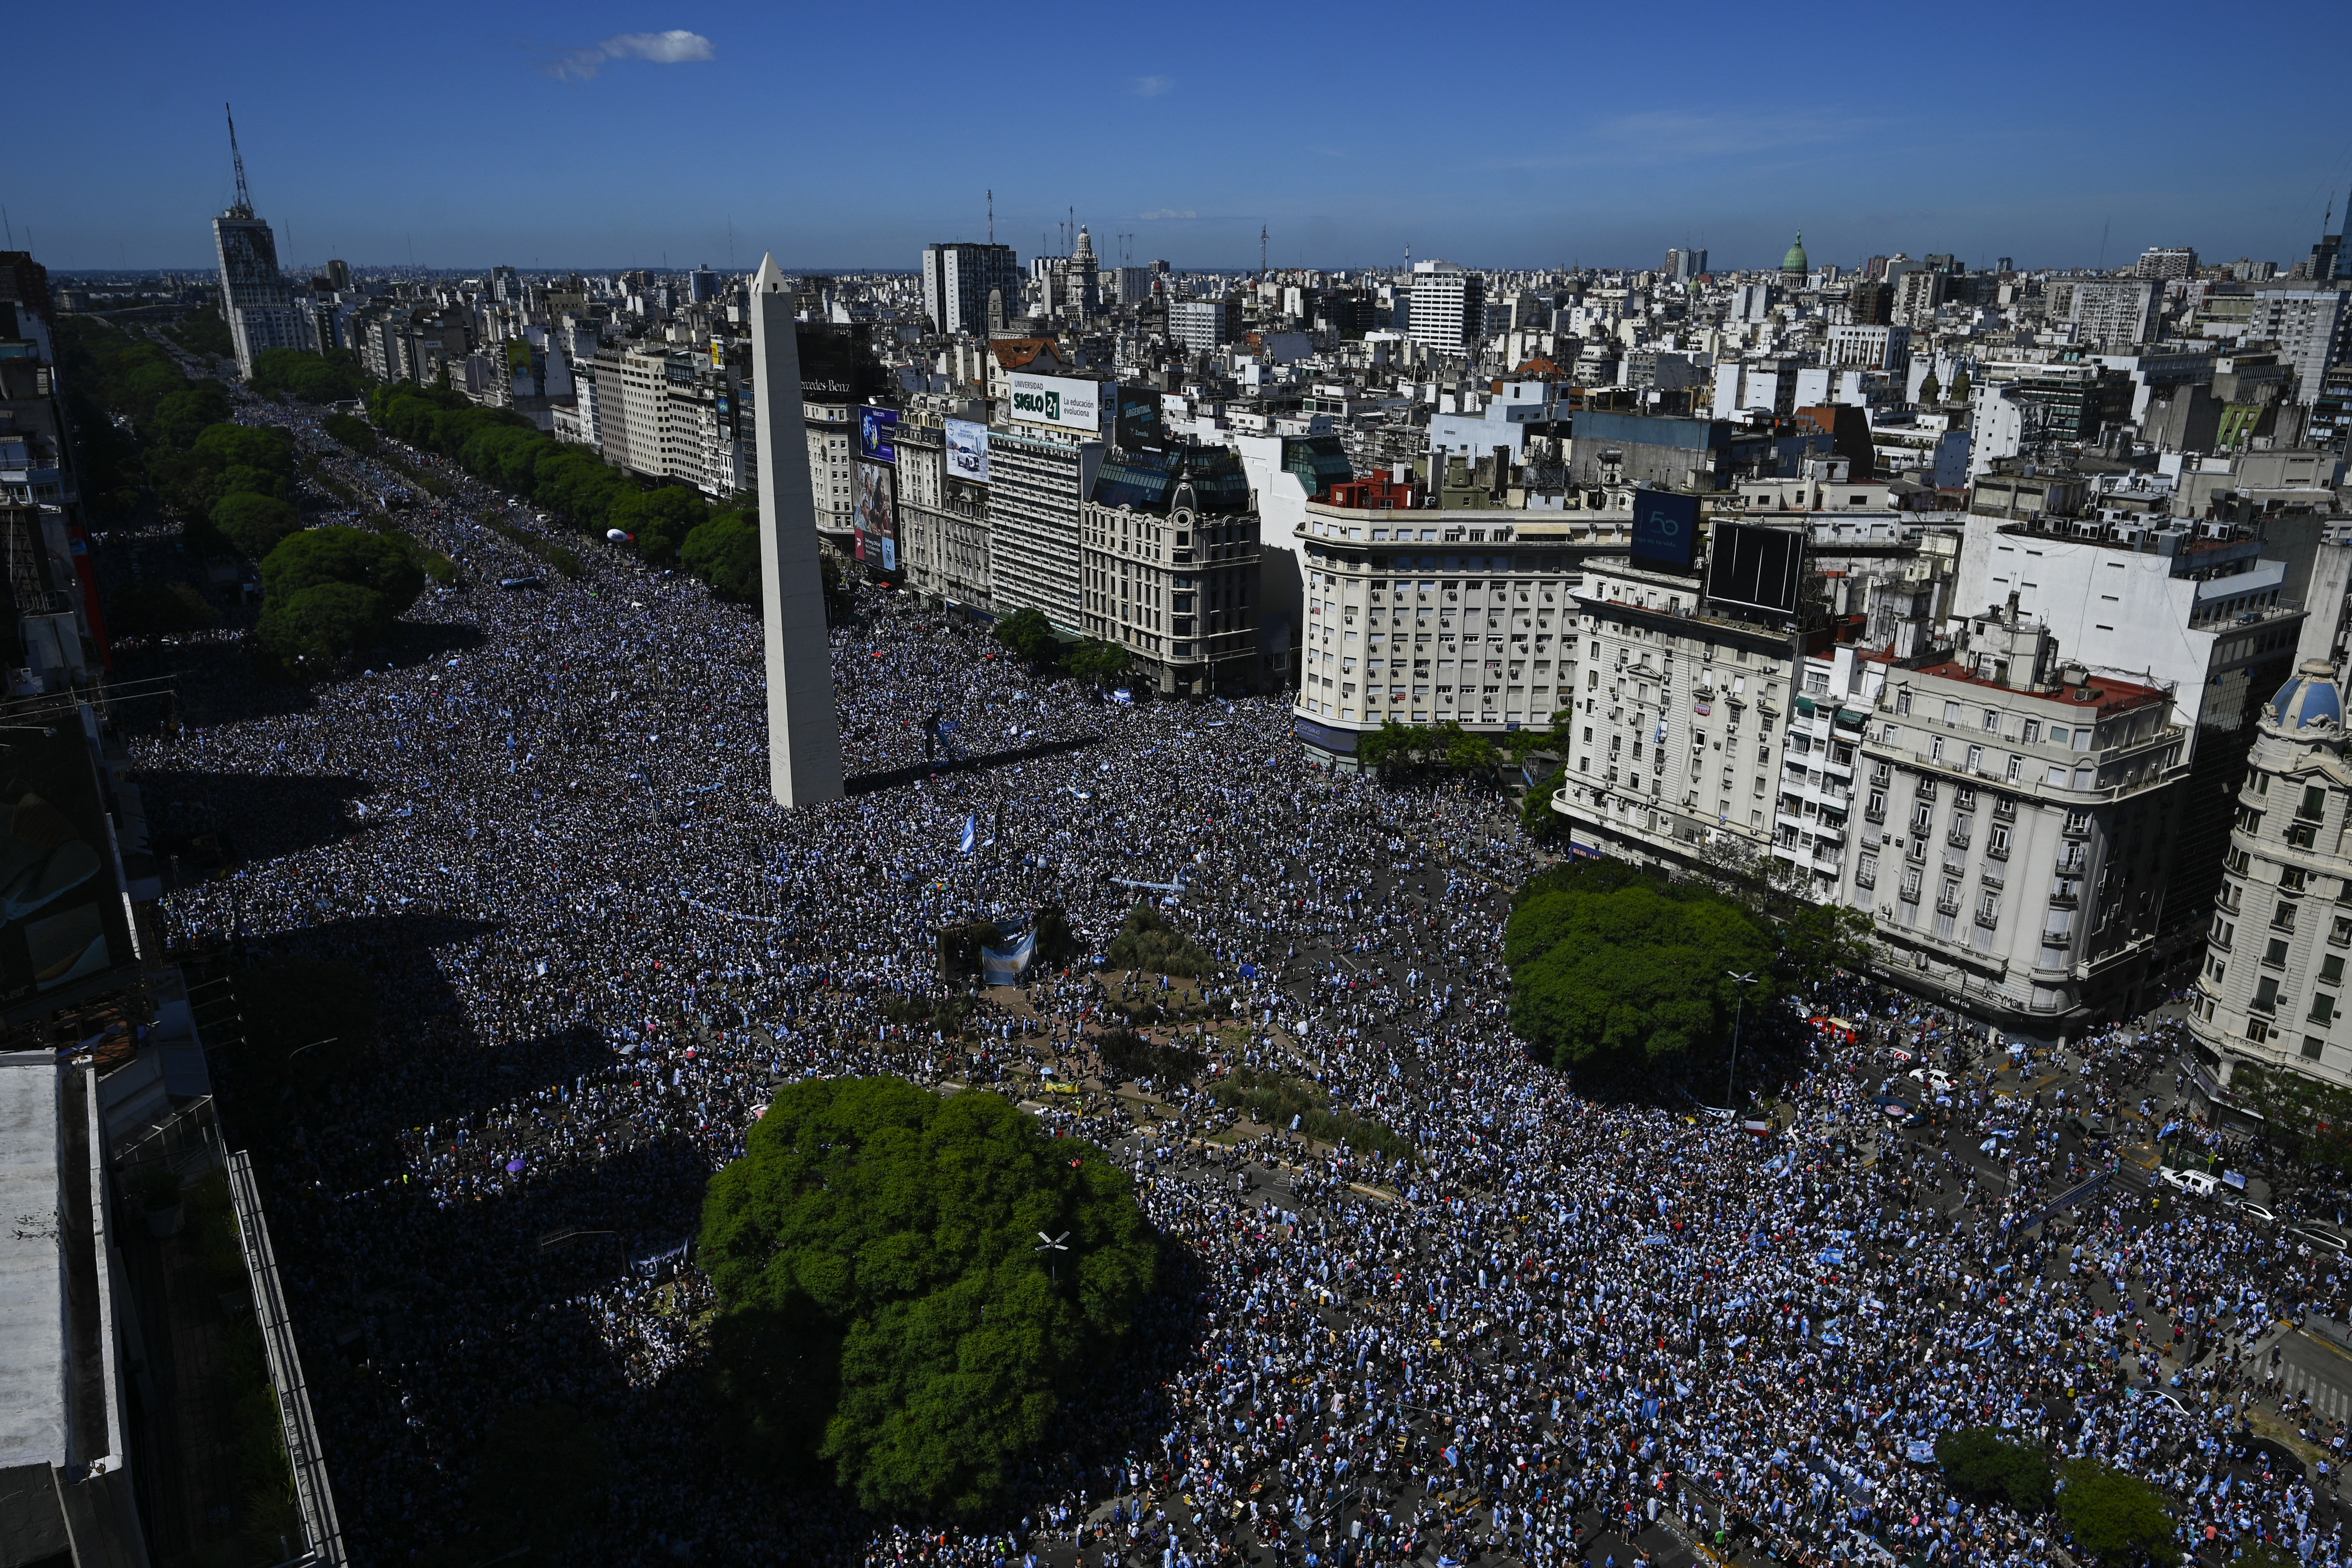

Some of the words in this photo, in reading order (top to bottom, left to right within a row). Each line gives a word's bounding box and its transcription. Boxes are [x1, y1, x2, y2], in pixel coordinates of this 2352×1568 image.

[801, 379, 851, 392] ercedes-Benz
[1014, 380, 1044, 390] UNIVERSIDAD
[1014, 392, 1044, 413] SIGLO
[1047, 396, 1057, 417] 21
[1070, 398, 1094, 409] educación
[1106, 401, 1114, 410] 21
[1064, 407, 1089, 417] evoluciona
[1125, 404, 1152, 418] ARGENTINA.
[1650, 511, 1678, 536] 50
[1298, 723, 1320, 735] nCorSalud
[1871, 966, 1890, 978] Galicia
[1949, 996, 1970, 1008] Galcia
